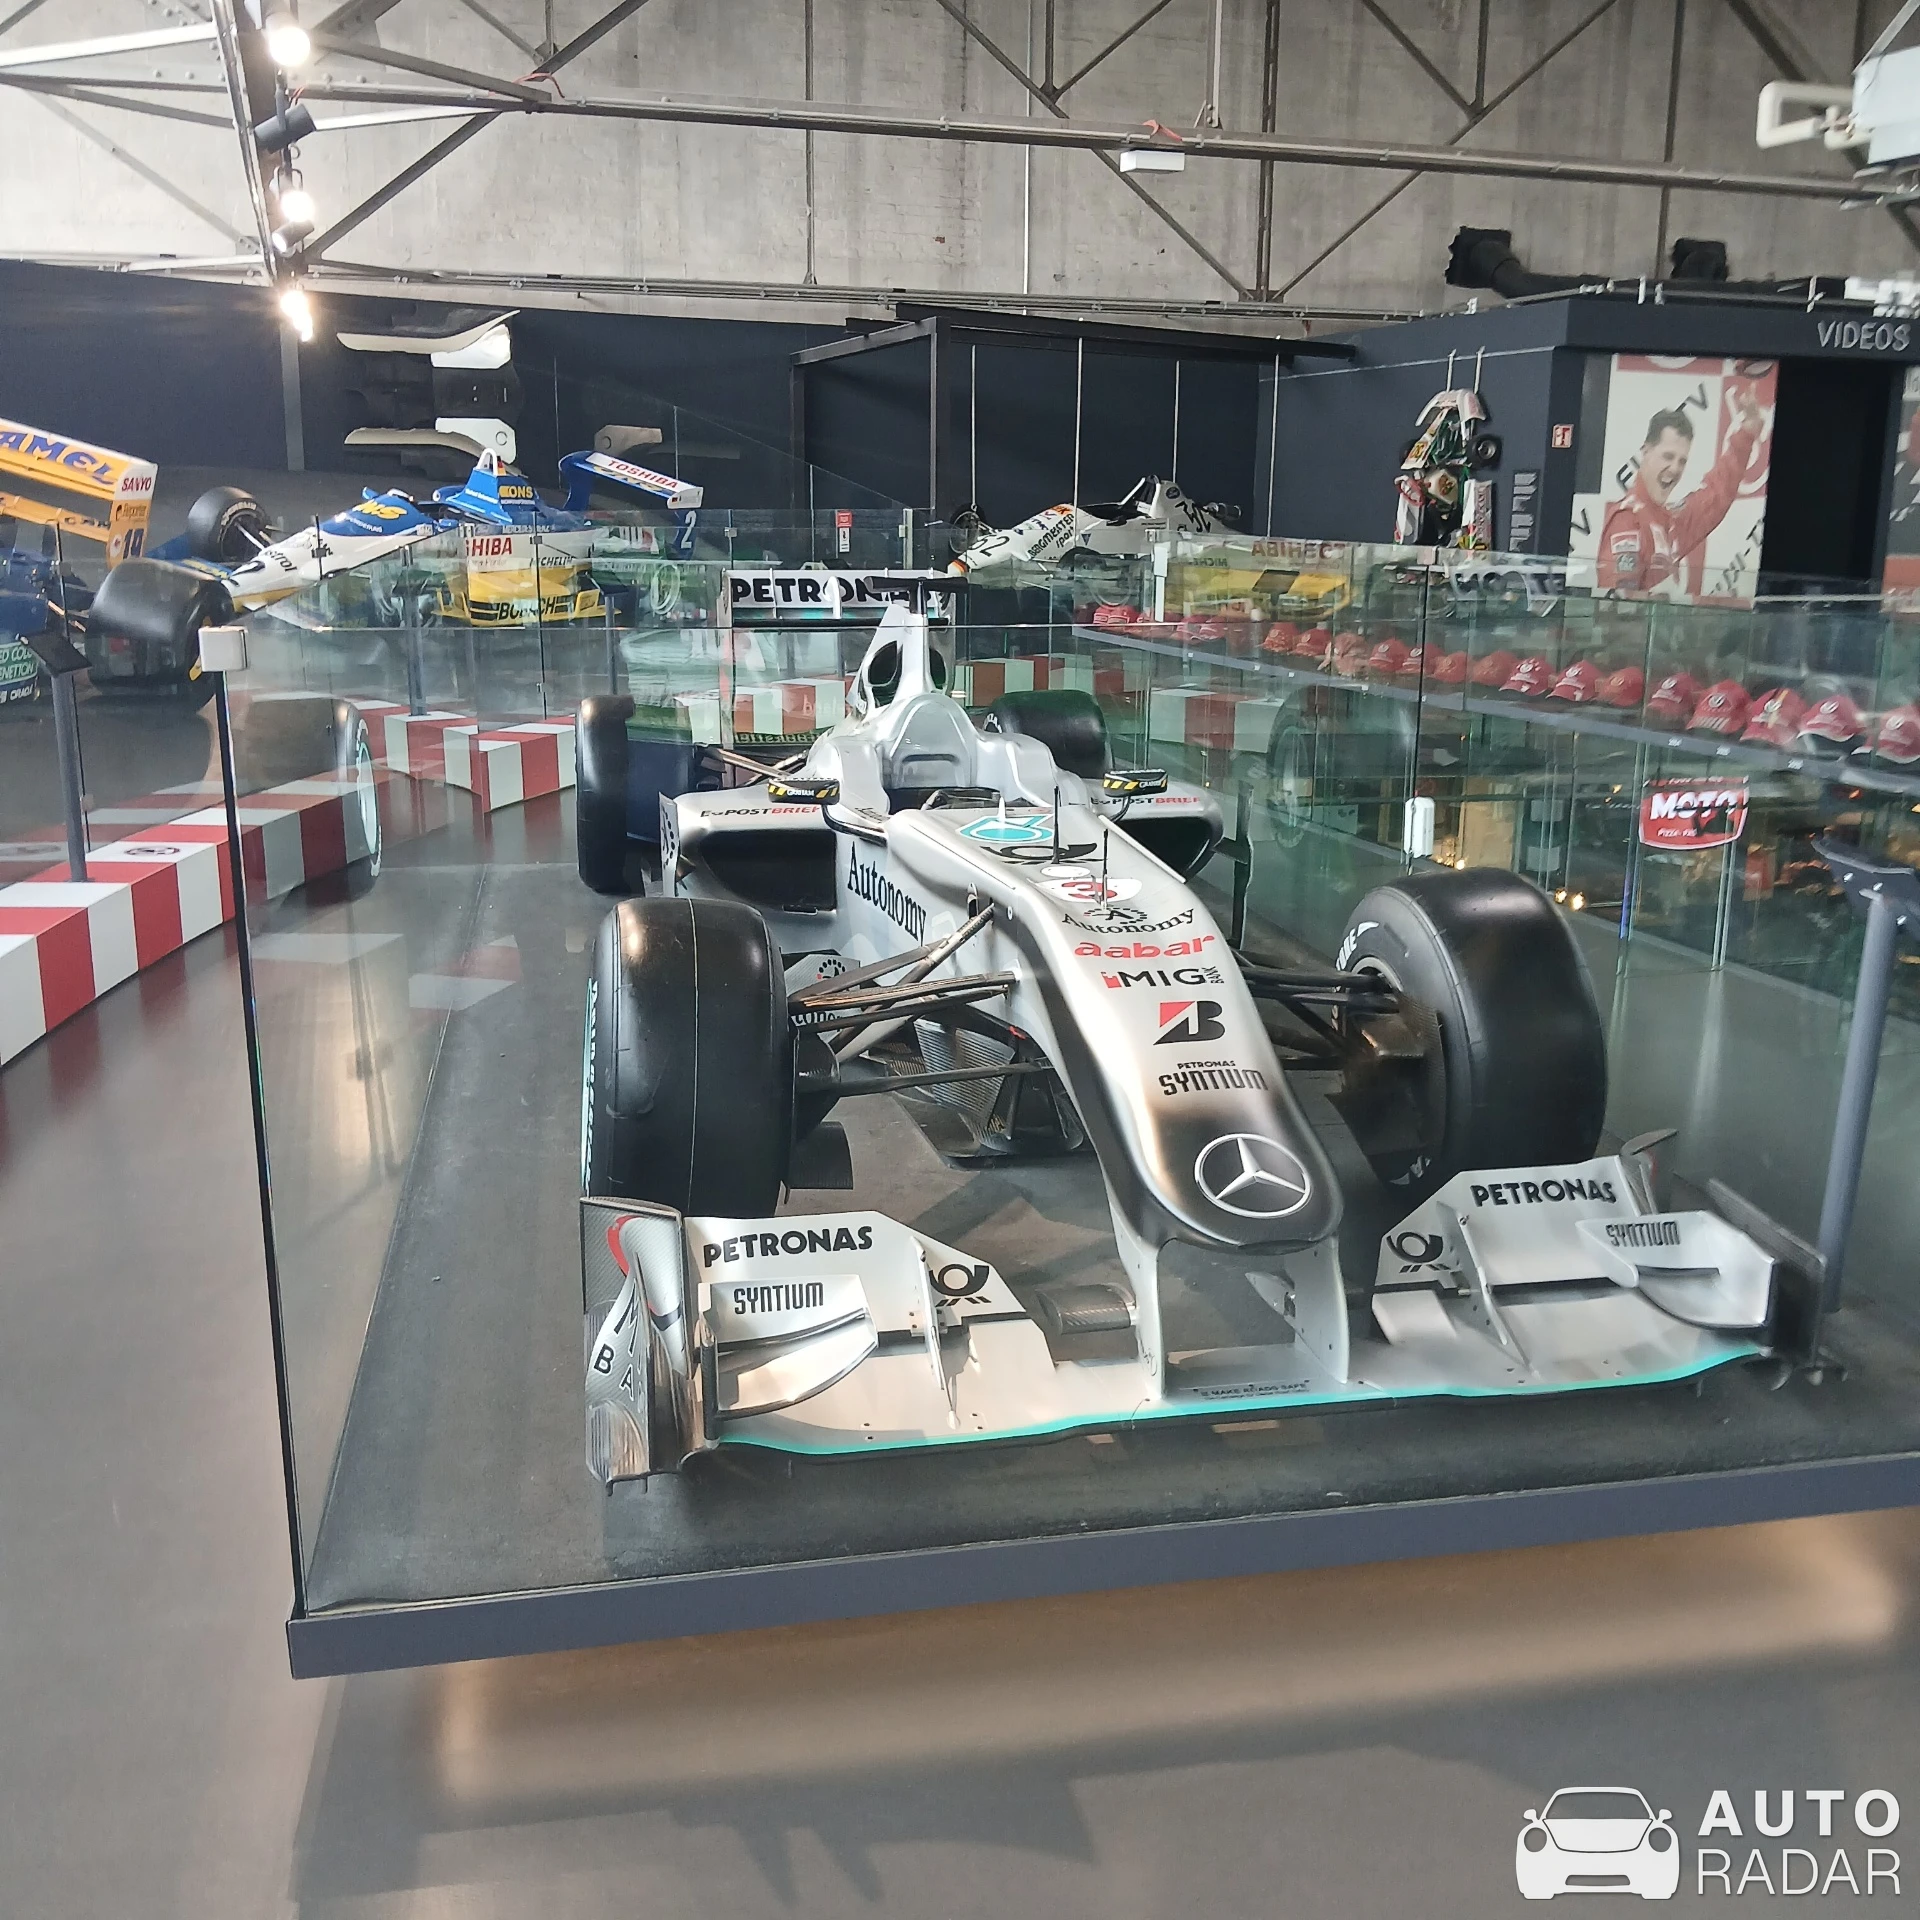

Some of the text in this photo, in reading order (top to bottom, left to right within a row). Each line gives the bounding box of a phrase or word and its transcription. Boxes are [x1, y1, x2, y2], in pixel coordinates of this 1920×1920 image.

[1817, 320, 1912, 352] VIDEOS
[0, 431, 118, 485] AMEL
[121, 476, 152, 492] SANYO
[607, 459, 679, 489] TOSHIBA
[680, 510, 697, 549] 2
[730, 577, 932, 603] PETRON
[847, 841, 927, 947] Autonomy
[1062, 908, 1195, 934] Autonomy
[1074, 935, 1215, 959] aabar
[1176, 1060, 1237, 1070] PETRONAS
[1158, 1068, 1269, 1096] SYNTIUM
[1470, 1178, 1617, 1208] PETRONAS
[703, 1226, 873, 1268] PETRONAS
[733, 1282, 824, 1315] SYNTIUM
